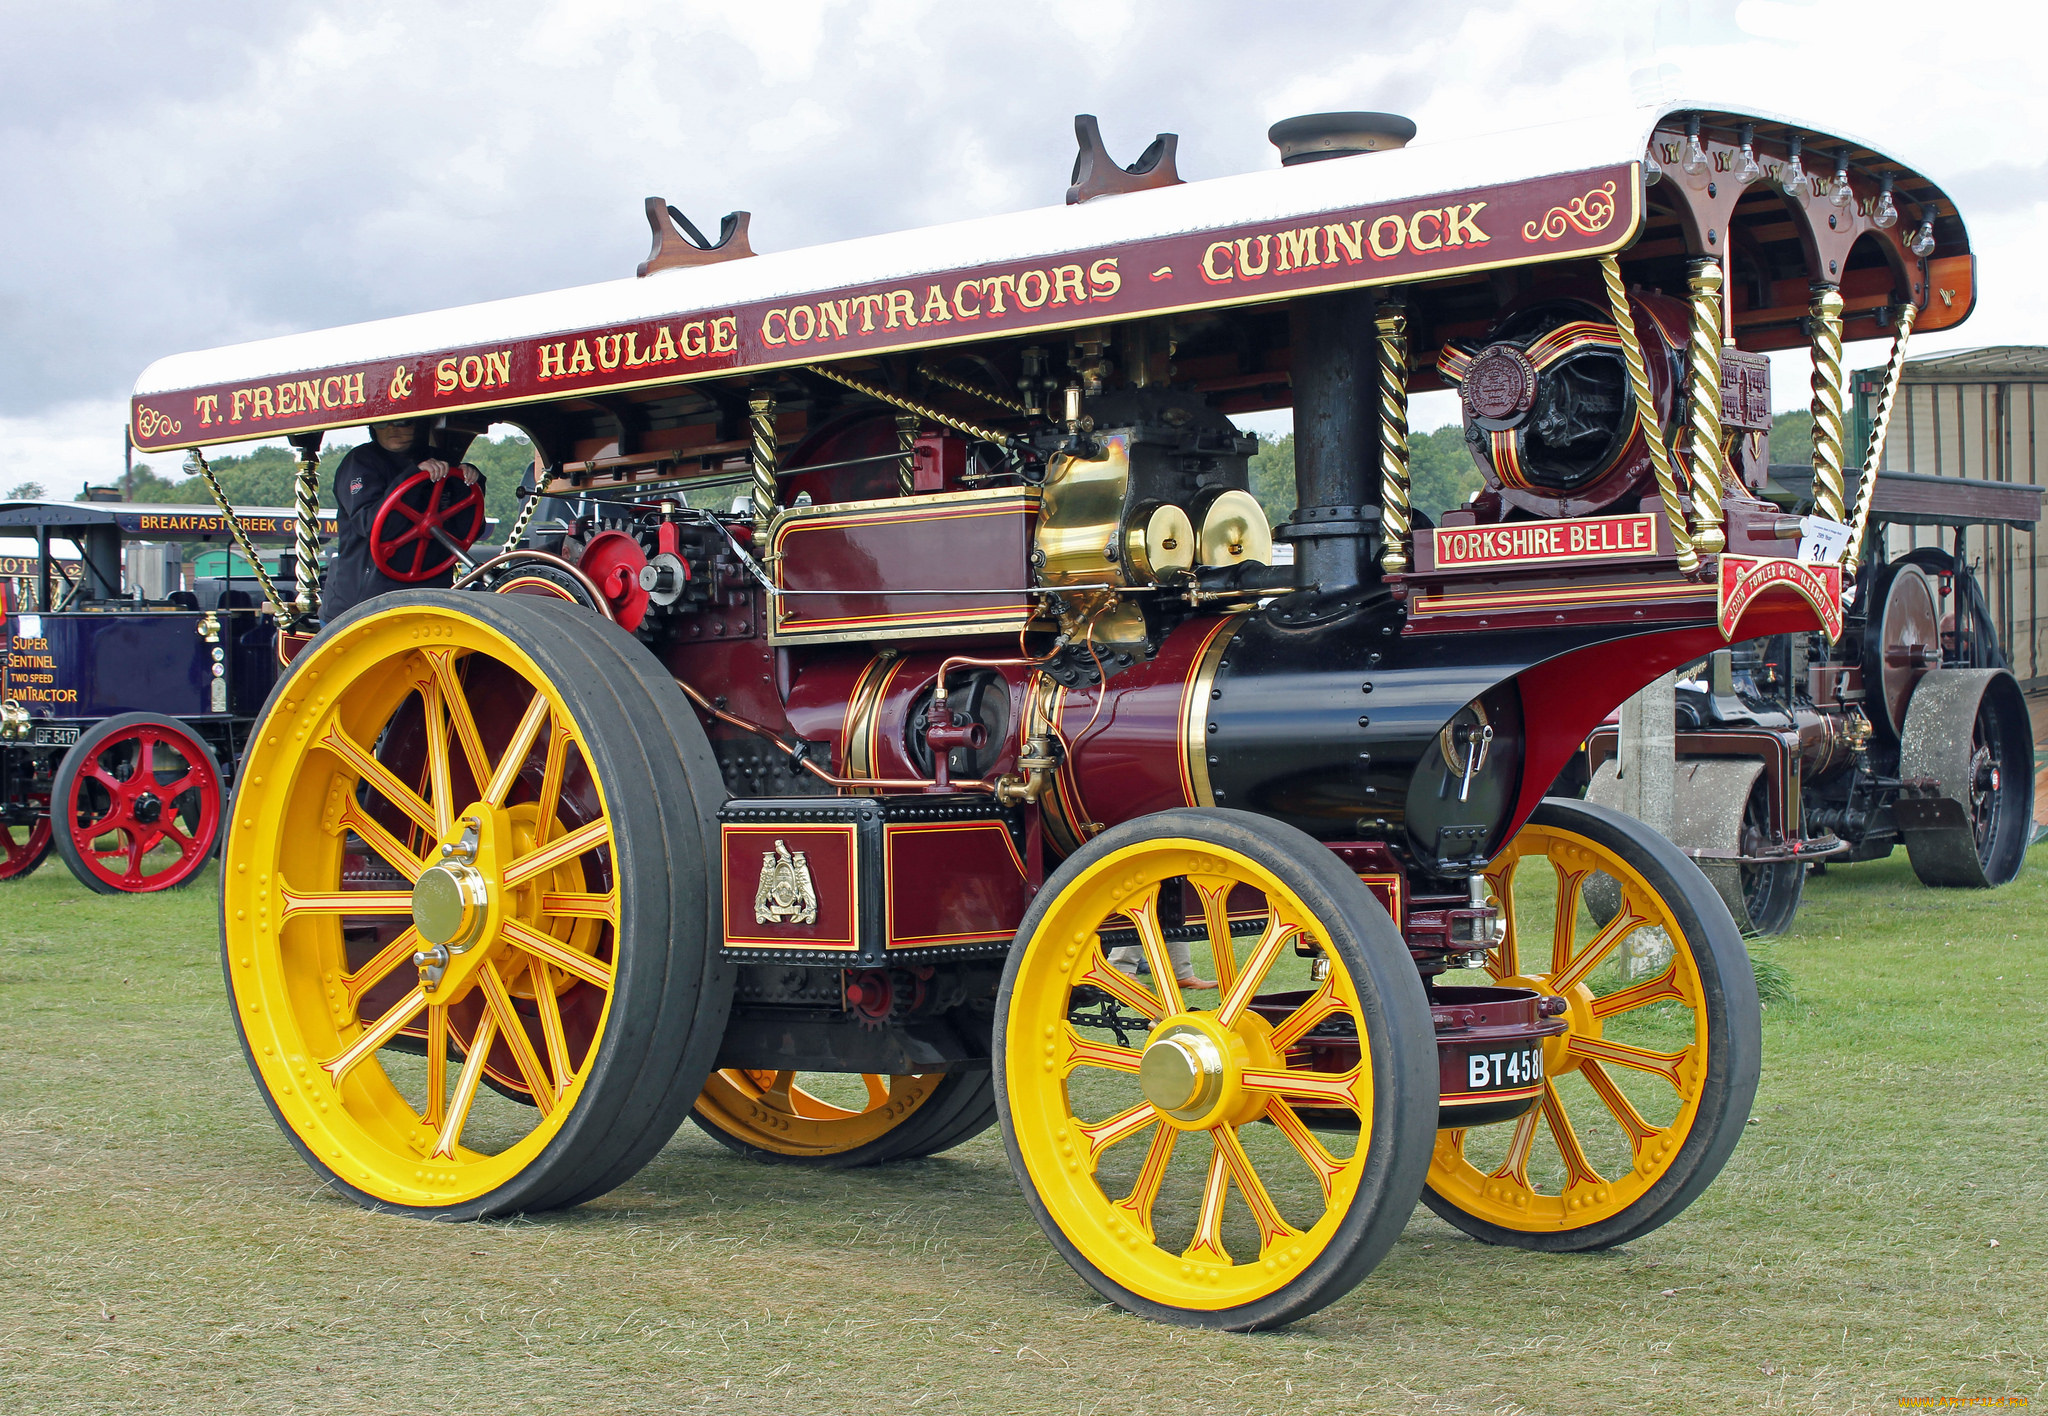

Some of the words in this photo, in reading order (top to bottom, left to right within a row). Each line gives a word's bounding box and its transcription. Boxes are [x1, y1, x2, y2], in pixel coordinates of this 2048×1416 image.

[194, 395, 224, 425] T.
[230, 372, 366, 422] FRENCH
[389, 365, 413, 401] &
[434, 350, 512, 396] SON
[537, 316, 738, 381] HAULAGE
[760, 257, 1122, 350] CONTRACTORS
[1199, 201, 1492, 285] CUMNOCK
[140, 515, 225, 530] BREAKFAST
[238, 518, 277, 532] REEK
[1441, 527, 1565, 561] YORKSHIRE
[1570, 521, 1649, 552] BELLE
[1730, 590, 1746, 620] JOHN
[1749, 565, 1776, 592] FOWLER
[1779, 564, 1786, 577] &
[1800, 572, 1826, 609] (LEEDS)
[12, 635, 48, 650] SUPER
[8, 653, 57, 668] SENTINEL
[10, 673, 29, 682] TWO
[30, 674, 54, 683] SPEED
[38, 730, 51, 743] BF
[53, 731, 77, 743] 5417
